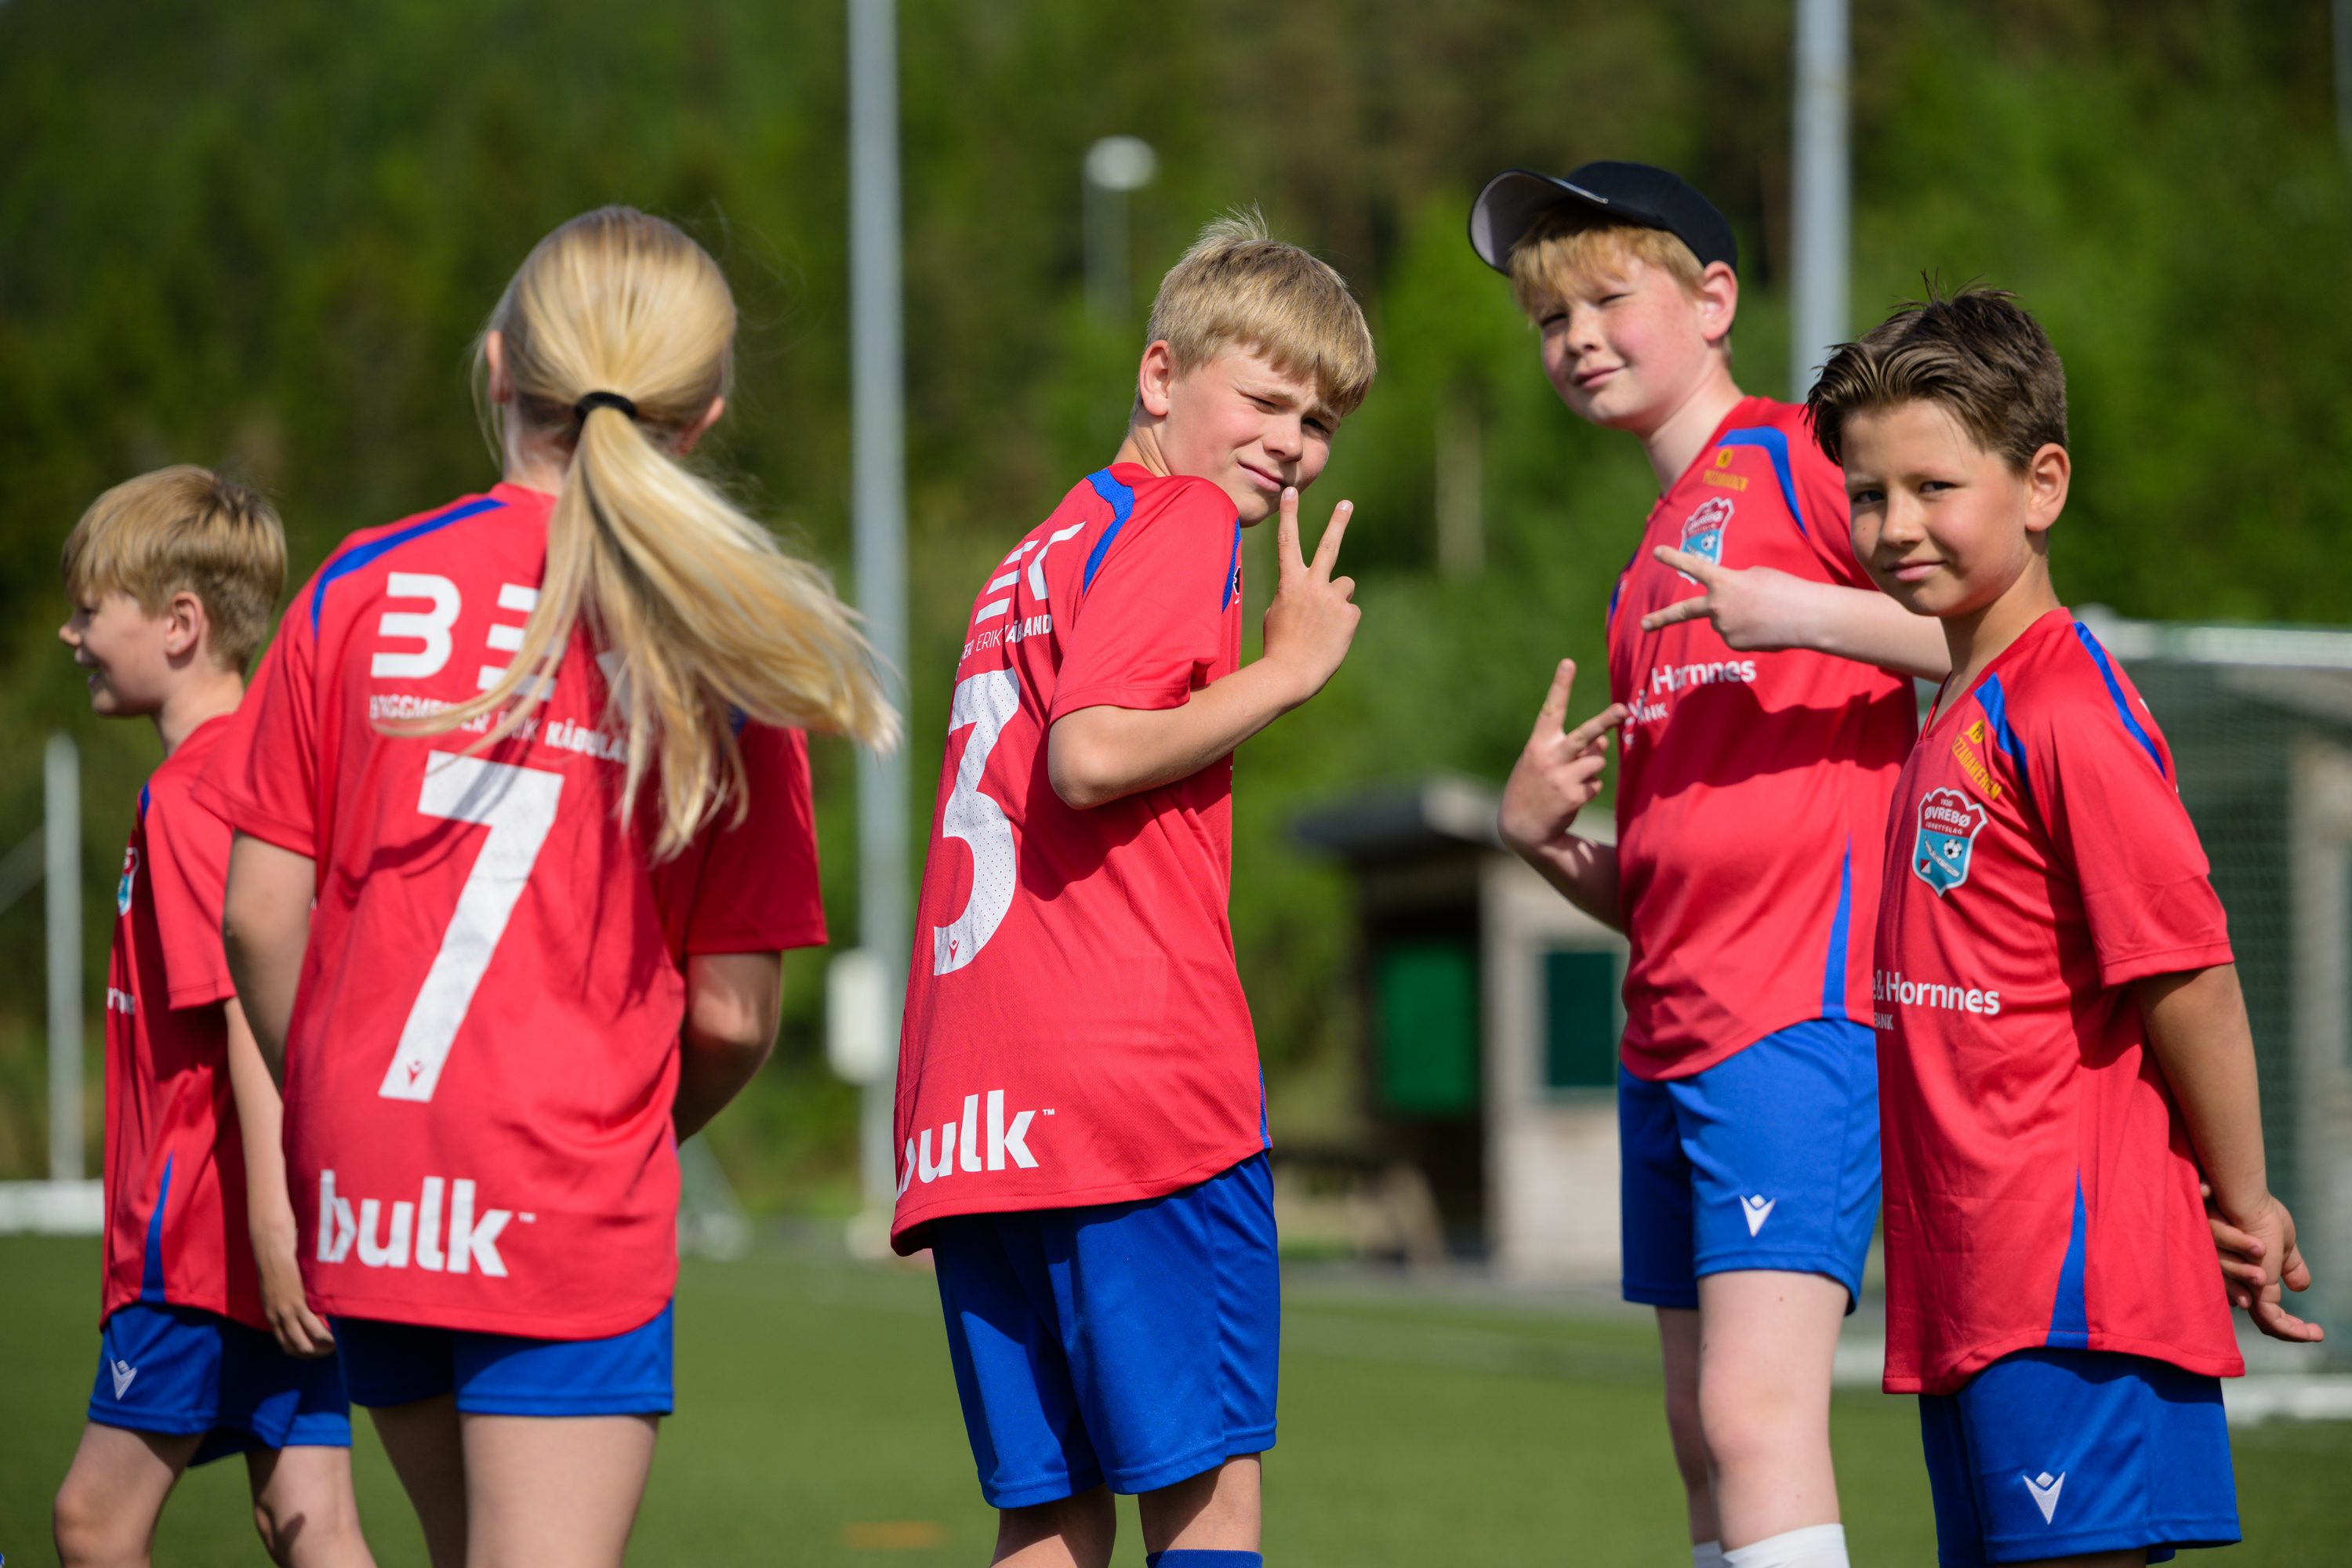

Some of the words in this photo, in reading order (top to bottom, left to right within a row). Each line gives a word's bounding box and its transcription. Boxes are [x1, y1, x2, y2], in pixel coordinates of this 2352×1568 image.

[975, 628, 1004, 652] ERIK
[1651, 660, 1757, 695] Hornnes
[934, 667, 1019, 976] 3
[1924, 805, 1972, 828] ØVREBØ
[378, 750, 564, 1103] 7
[1886, 971, 2000, 1015] Hornnes
[317, 1169, 514, 1278] bulk
